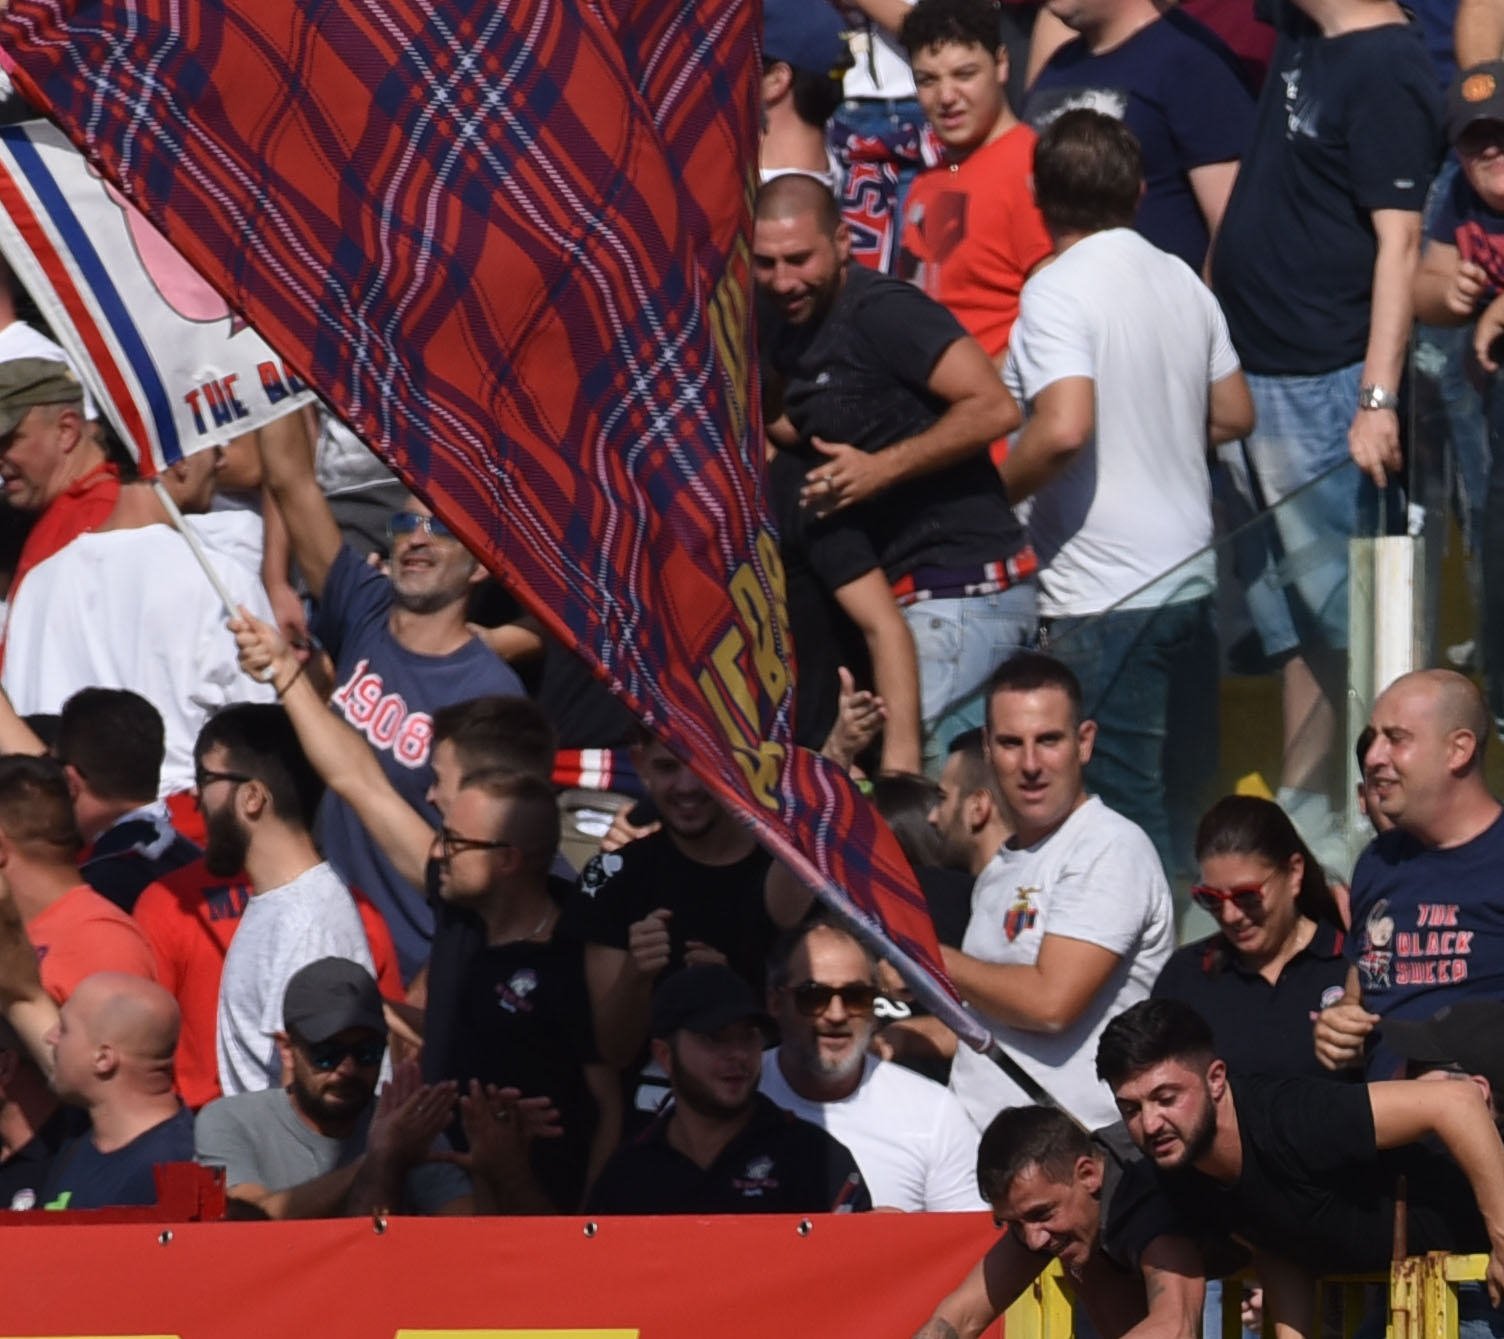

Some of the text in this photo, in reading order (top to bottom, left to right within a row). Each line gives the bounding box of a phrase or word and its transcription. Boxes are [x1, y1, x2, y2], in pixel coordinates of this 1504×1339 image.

[331, 659, 434, 769] 1908
[1416, 904, 1460, 927] THE
[1397, 930, 1475, 958] BLACK
[1396, 958, 1469, 985] SHEEP
